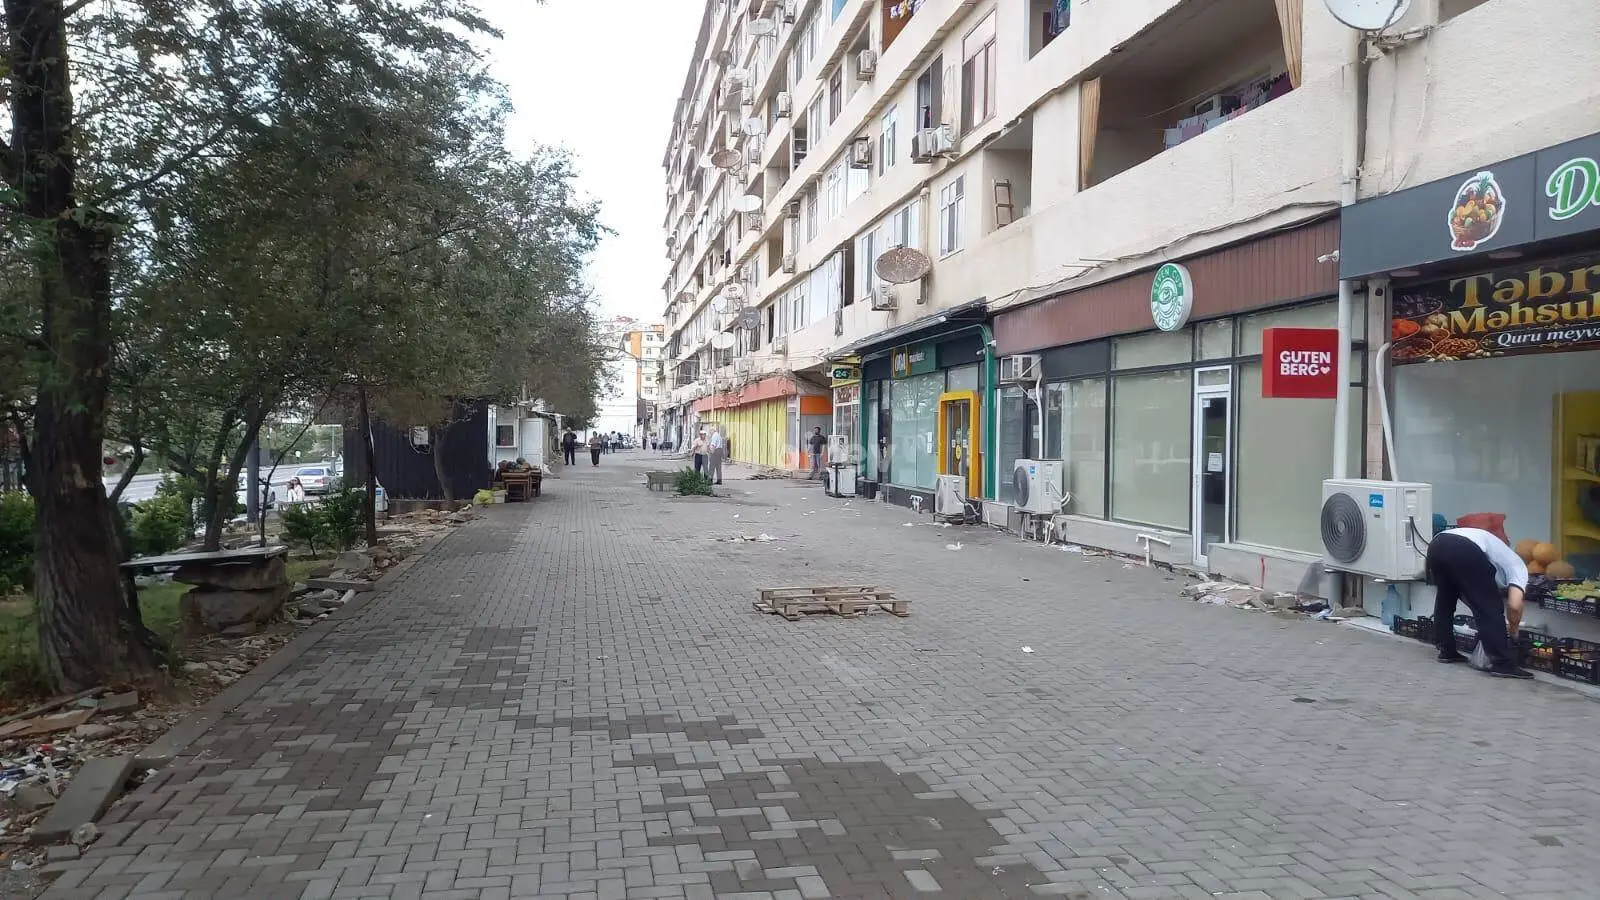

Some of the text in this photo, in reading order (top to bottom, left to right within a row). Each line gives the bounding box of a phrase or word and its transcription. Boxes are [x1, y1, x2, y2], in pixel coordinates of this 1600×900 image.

[1498, 330, 1541, 347] Quru
[1279, 350, 1331, 363] GUTEN
[1280, 363, 1320, 376] BERG
